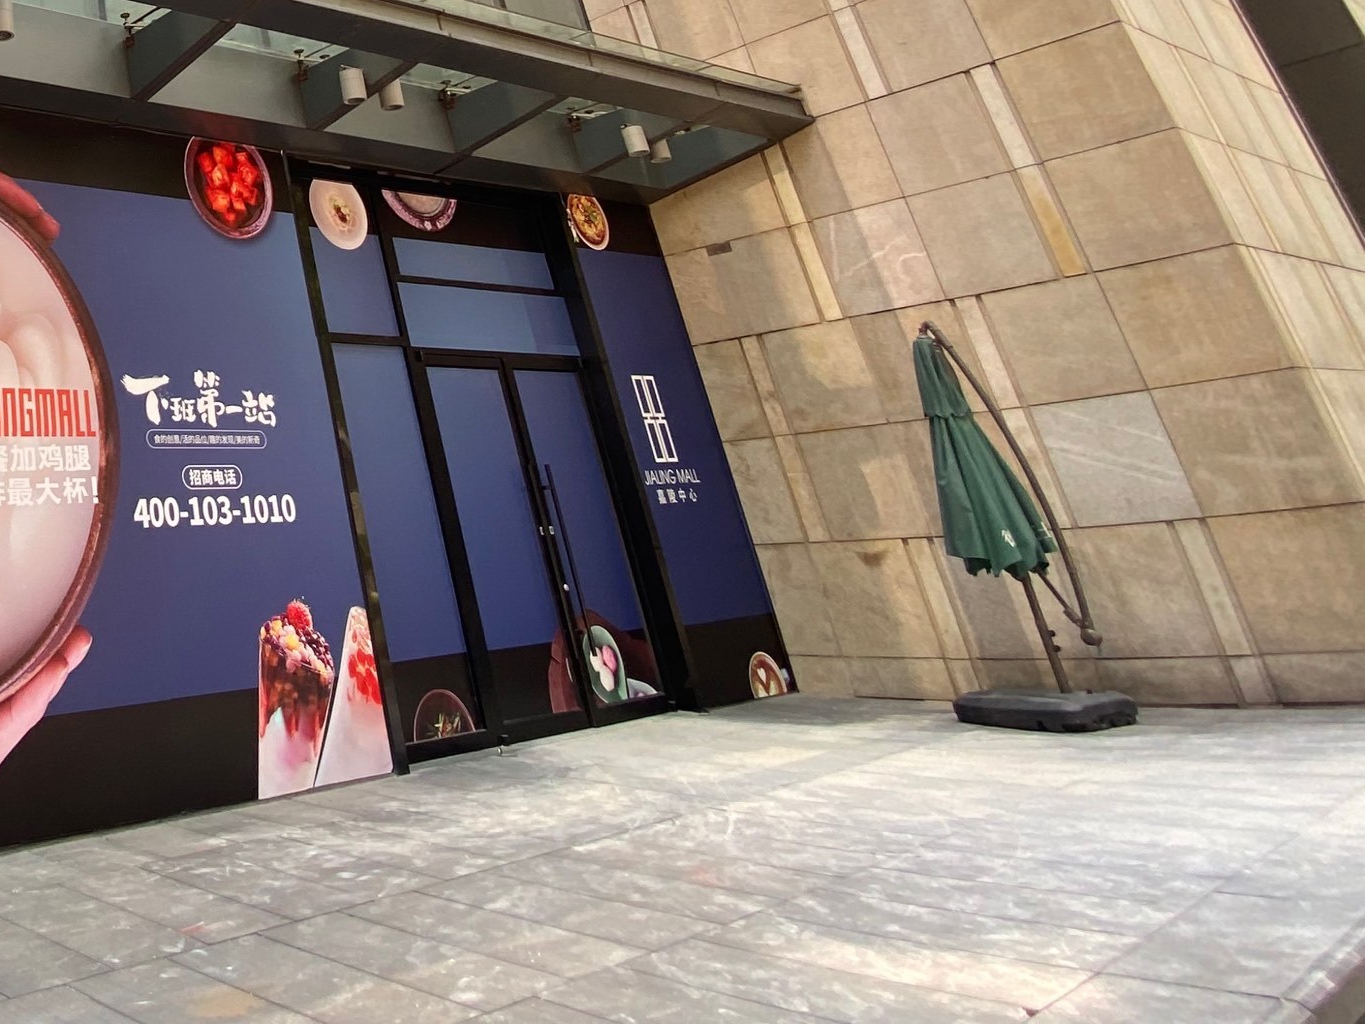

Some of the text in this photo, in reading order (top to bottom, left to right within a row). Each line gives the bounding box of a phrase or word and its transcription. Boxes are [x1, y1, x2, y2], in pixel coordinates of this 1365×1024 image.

[120, 370, 277, 428] 下班第一站
[189, 468, 237, 486] 招商电话
[134, 494, 296, 528] 400-103-1010
